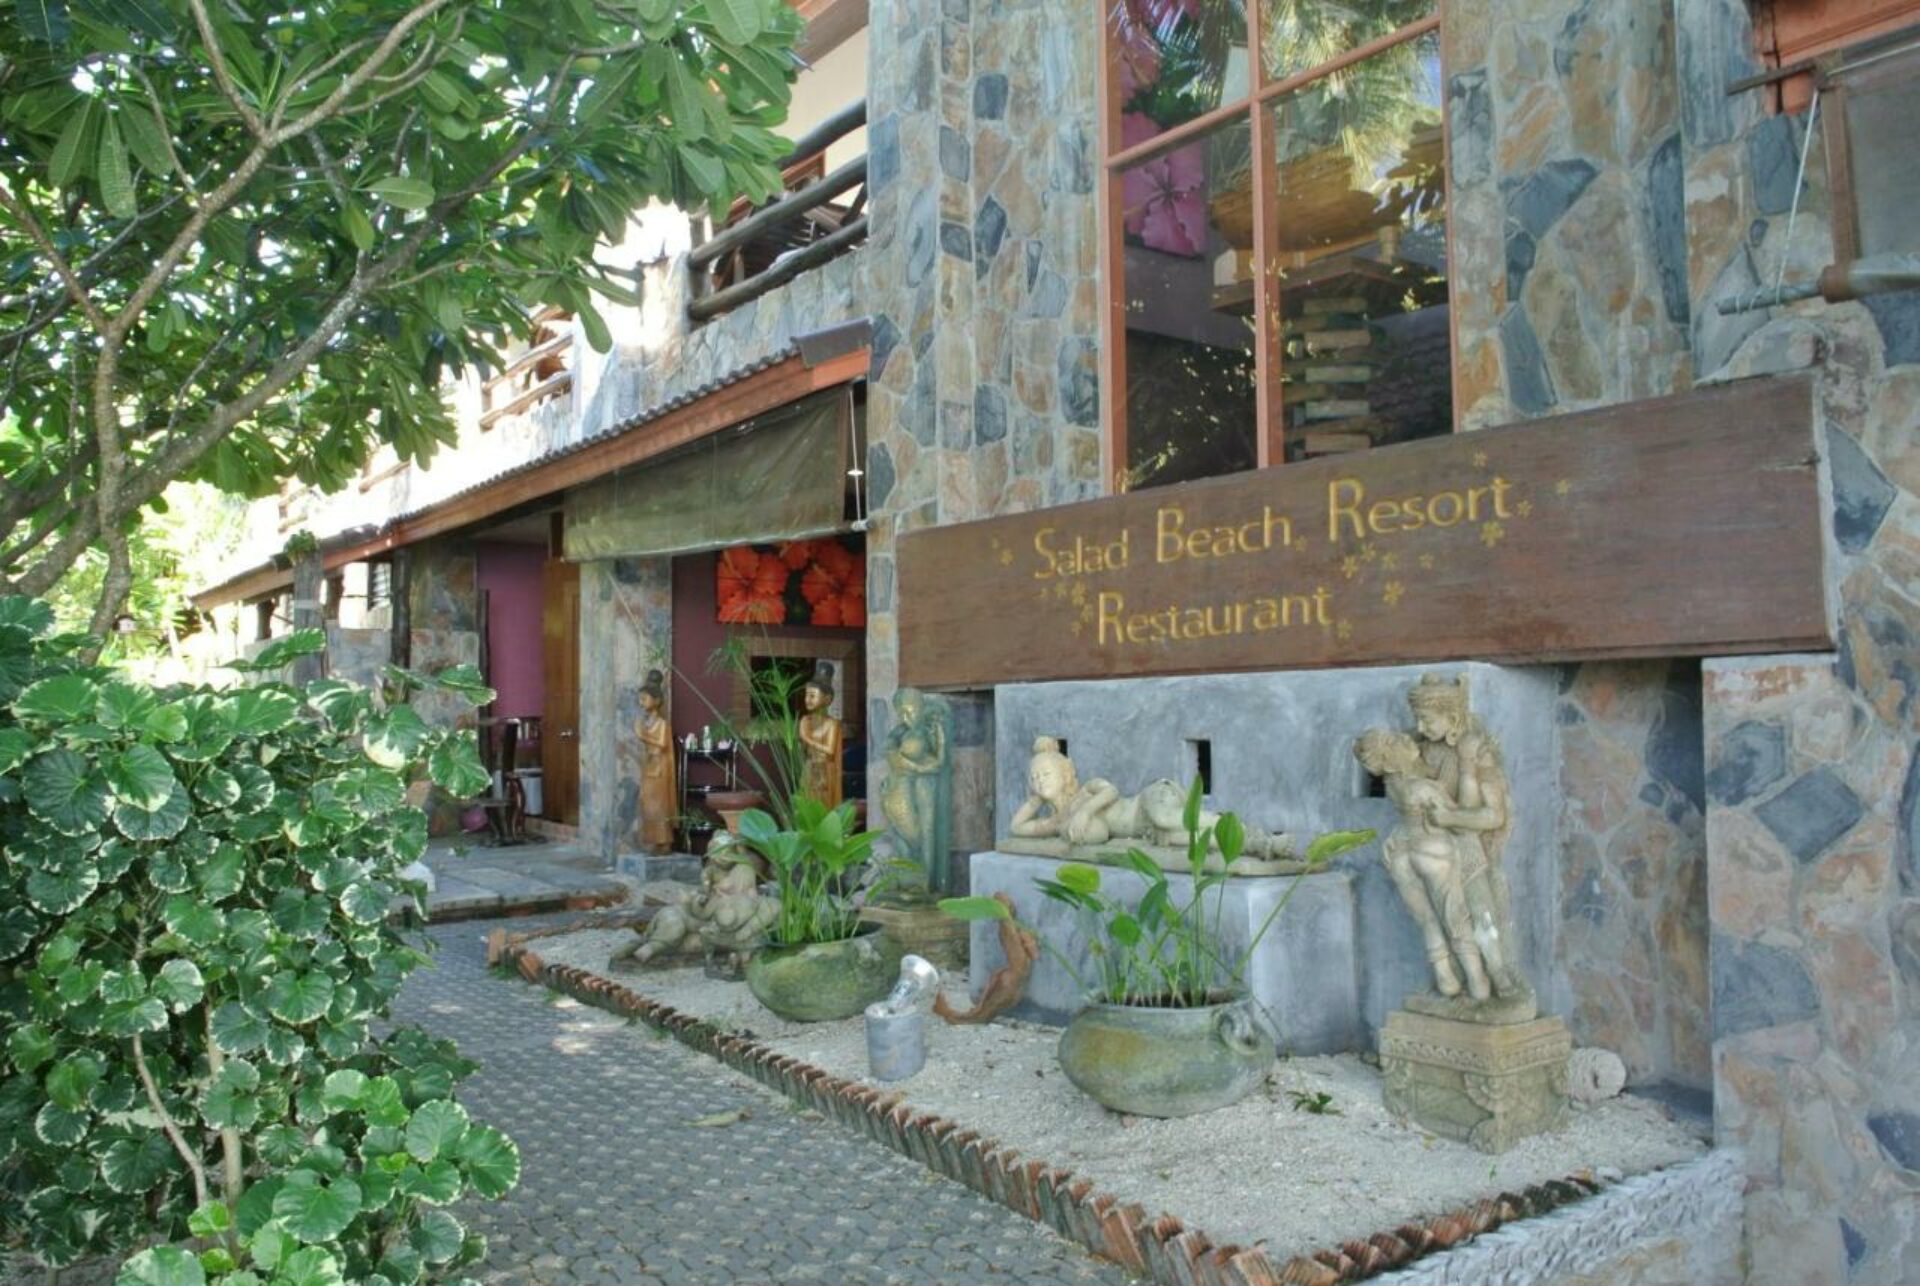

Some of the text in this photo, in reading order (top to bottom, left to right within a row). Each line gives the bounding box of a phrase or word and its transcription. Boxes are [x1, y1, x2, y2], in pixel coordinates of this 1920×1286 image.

[1033, 477, 1512, 579] Salad Beach Resort
[1098, 586, 1335, 645] Restaurant
